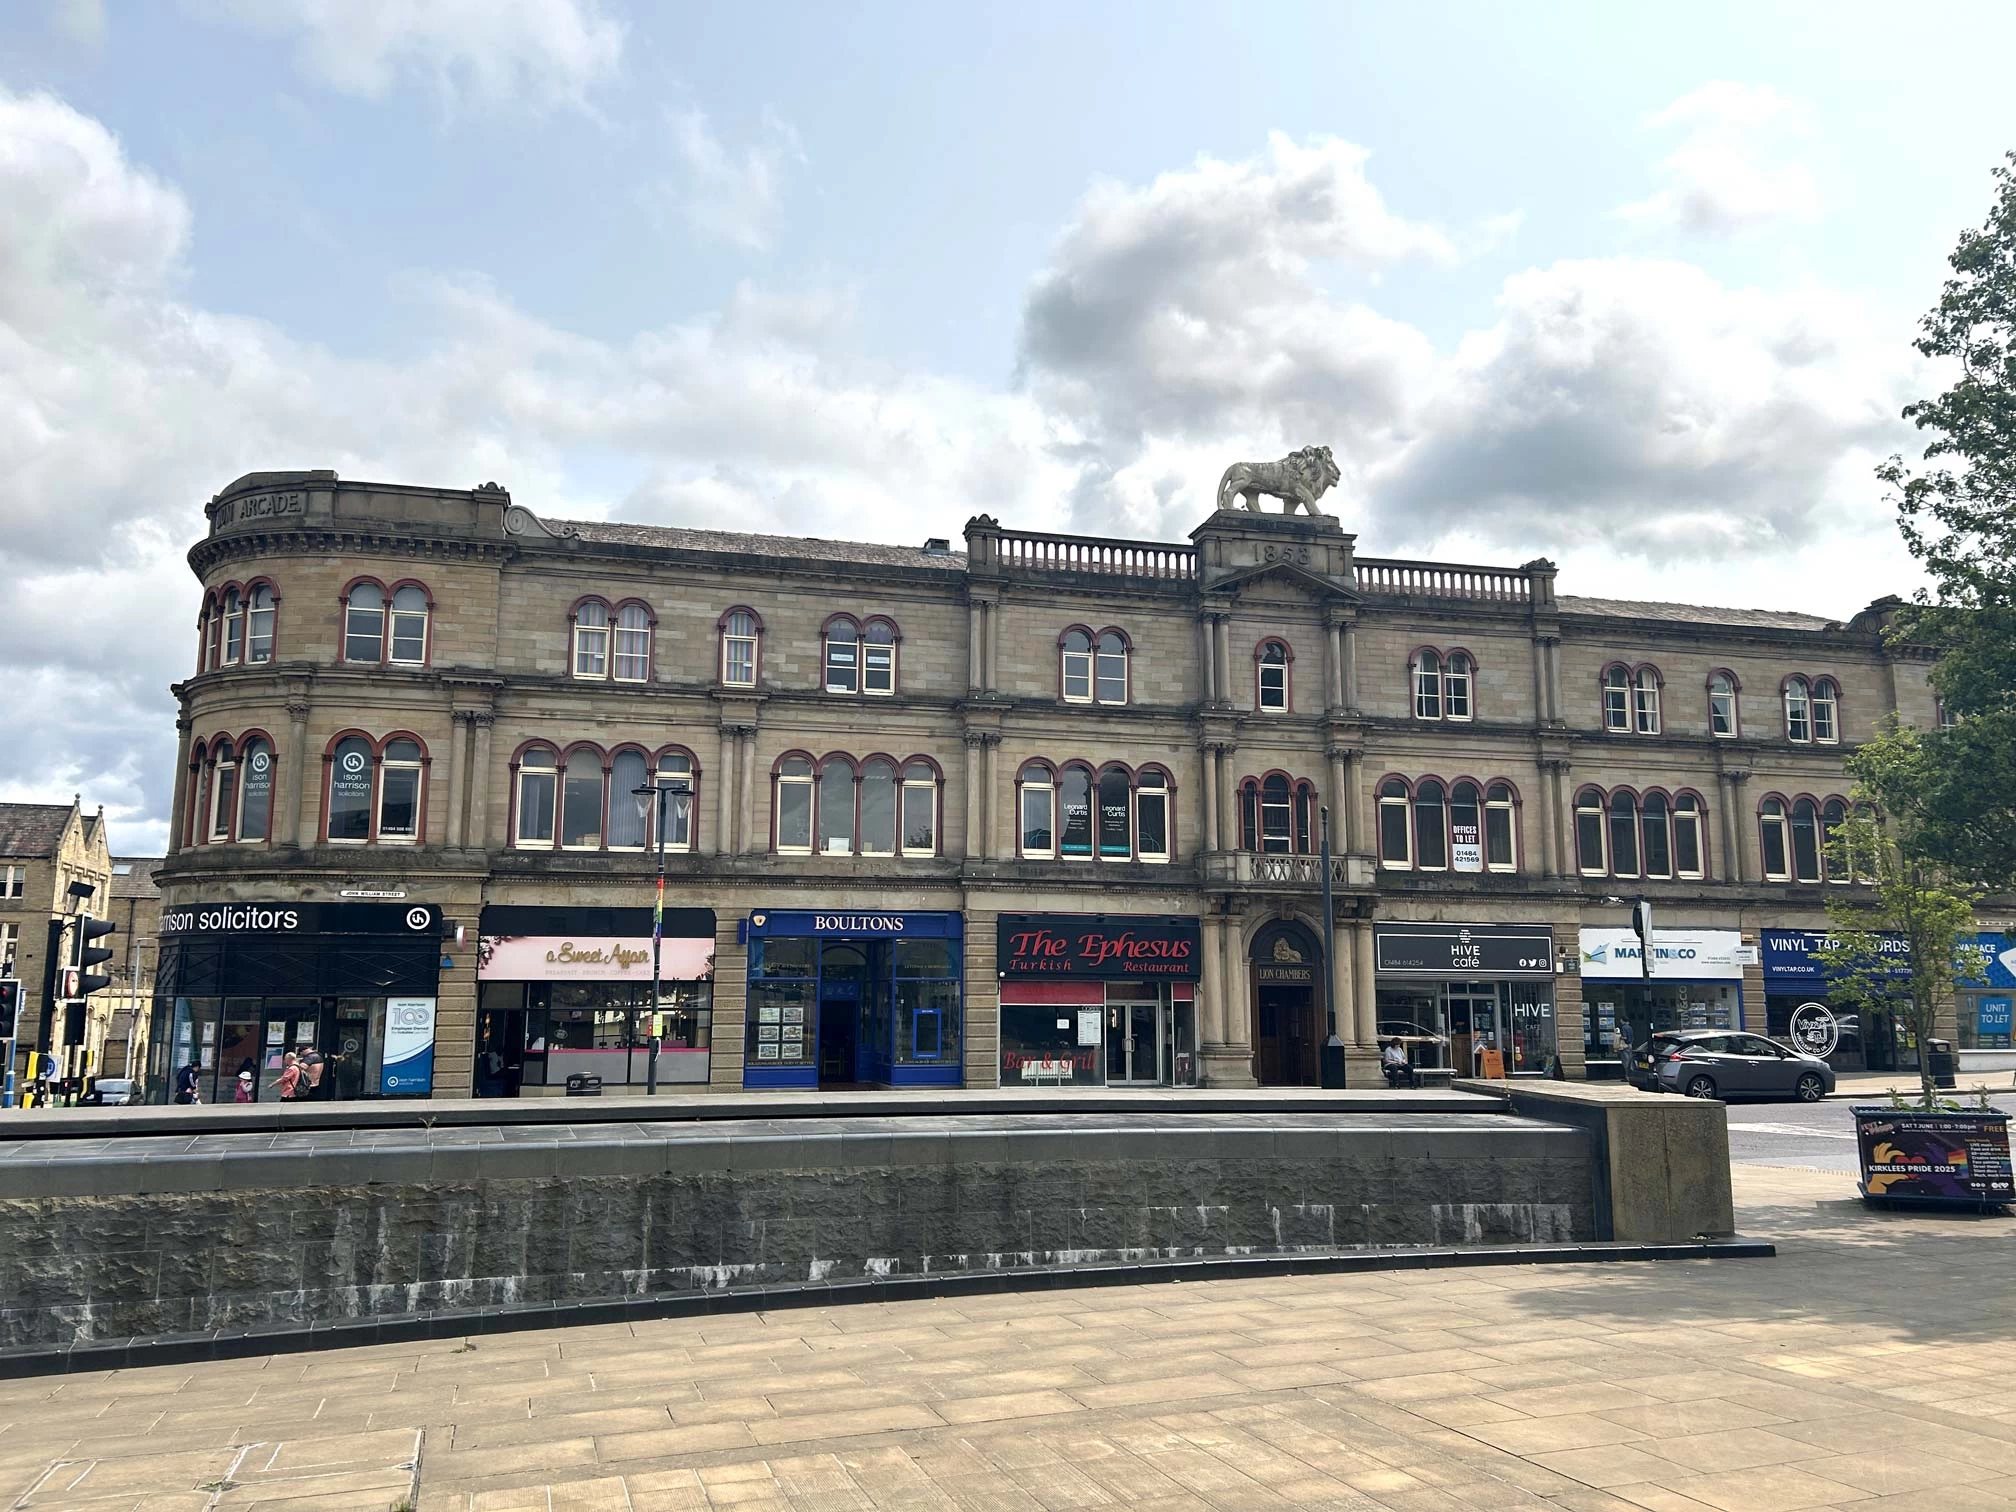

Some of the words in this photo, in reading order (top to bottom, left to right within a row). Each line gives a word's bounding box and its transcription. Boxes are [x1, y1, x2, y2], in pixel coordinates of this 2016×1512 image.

[343, 773, 362, 781] ison
[334, 781, 370, 790] harrison
[1453, 825, 1477, 834] OFFICES
[1455, 834, 1464, 843] TO
[1464, 835, 1476, 843] LET
[159, 909, 194, 932] arrison
[199, 906, 299, 930] solicitors
[814, 915, 904, 931] BOULTONS
[1009, 930, 1068, 956] The
[1077, 931, 1192, 966] Ephesus
[1450, 945, 1481, 956] HIVE
[1770, 938, 1809, 951] VINYL
[1815, 939, 1840, 951] TAP
[557, 941, 602, 964] Sweet
[604, 943, 650, 969] Affair
[1009, 958, 1072, 971] Turkish
[1122, 961, 1189, 973] Restaurant
[1452, 955, 1480, 968] café
[1259, 968, 1274, 979] LION
[1275, 968, 1311, 980] CHAMBERS
[1514, 1003, 1551, 1017] HIVE
[1985, 1003, 2006, 1013] UNIT
[1981, 1014, 1994, 1023] TO
[1994, 1015, 2009, 1023] LET
[1003, 1052, 1034, 1070] Bar
[1042, 1053, 1054, 1069] &
[1059, 1051, 1098, 1073] Grill
[1984, 1125, 2006, 1133] FREE
[1869, 1165, 1906, 1173] KIRKLEES
[1908, 1165, 1933, 1173] PRIDE
